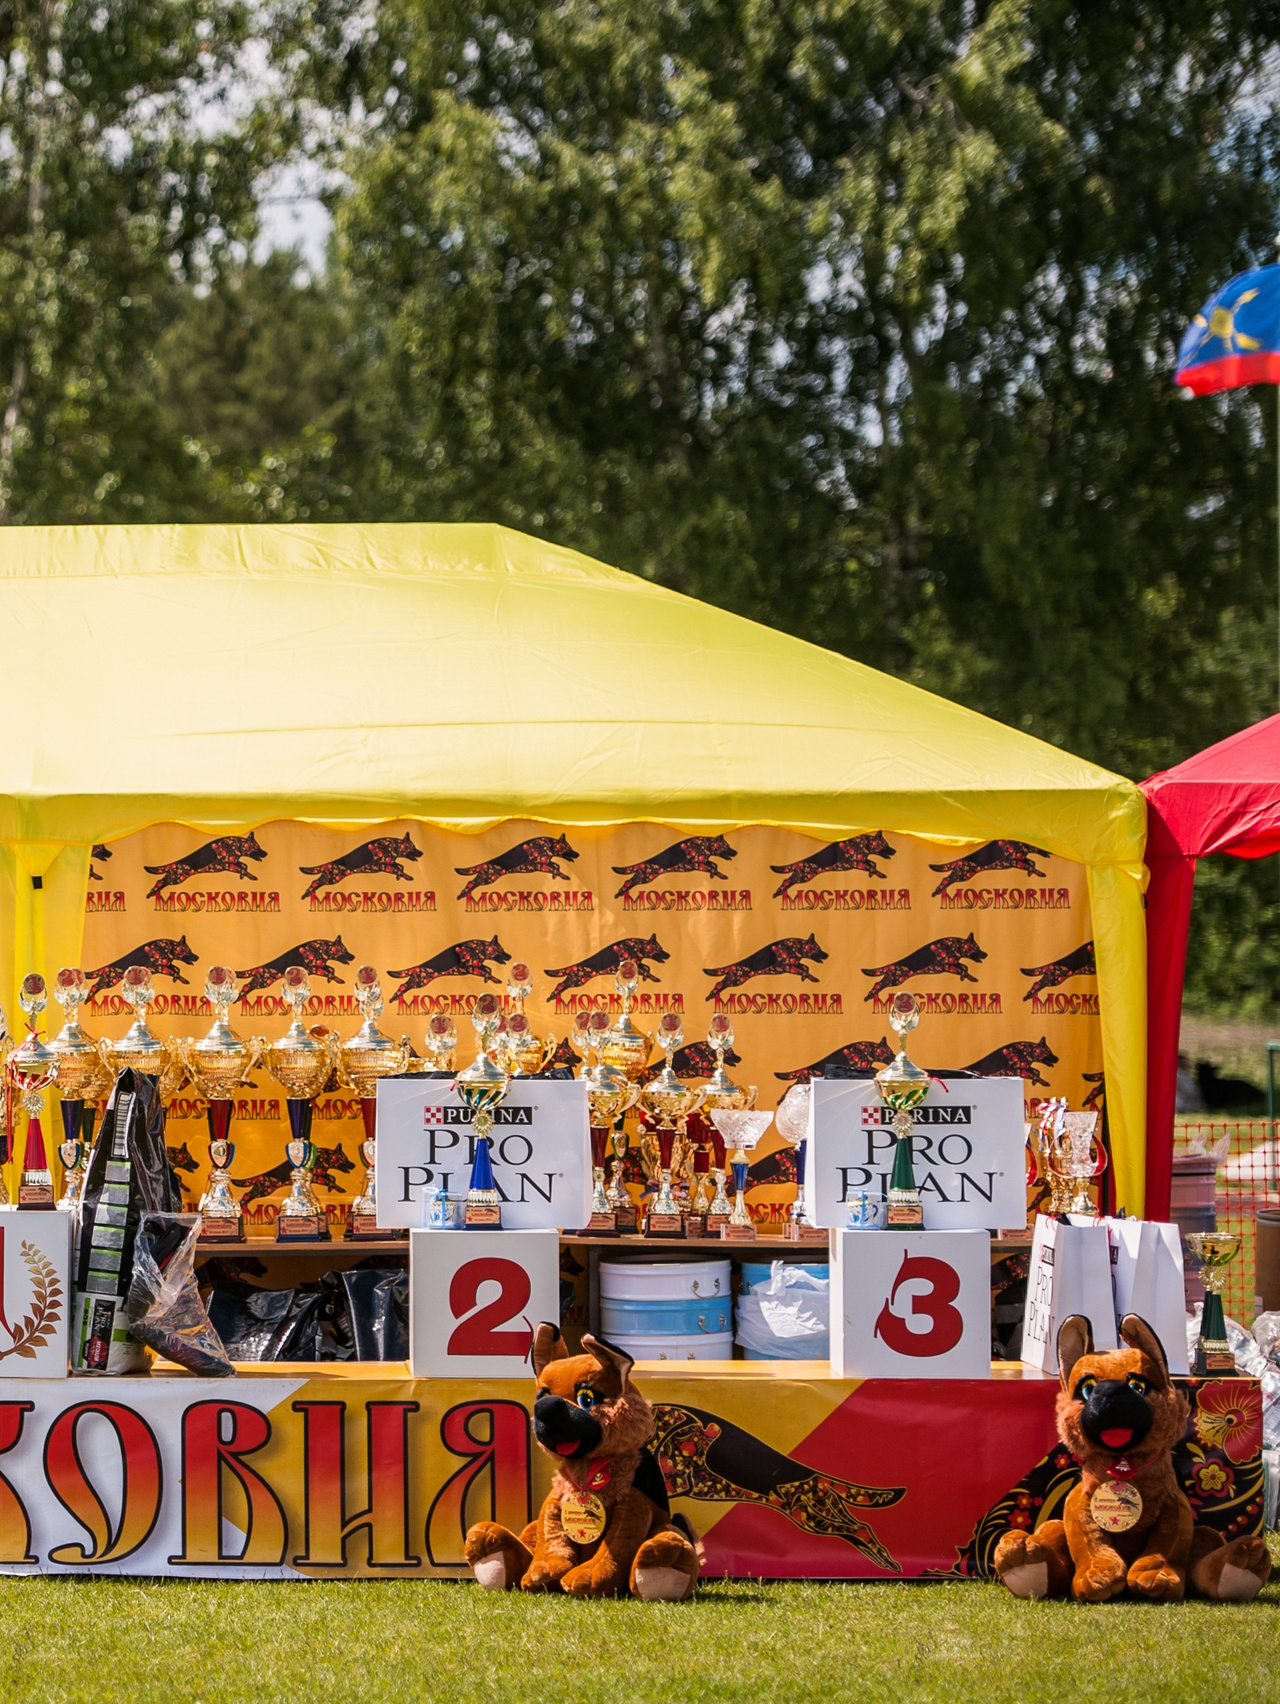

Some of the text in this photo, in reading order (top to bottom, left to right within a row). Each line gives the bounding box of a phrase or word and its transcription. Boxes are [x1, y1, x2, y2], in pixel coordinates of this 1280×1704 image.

[446, 1108, 530, 1123] PUINA
[884, 1108, 968, 1123] PRINA
[423, 1129, 534, 1165] PRO
[861, 1129, 973, 1166] PRO
[447, 1257, 534, 1364] 2
[874, 1249, 963, 1357] 3
